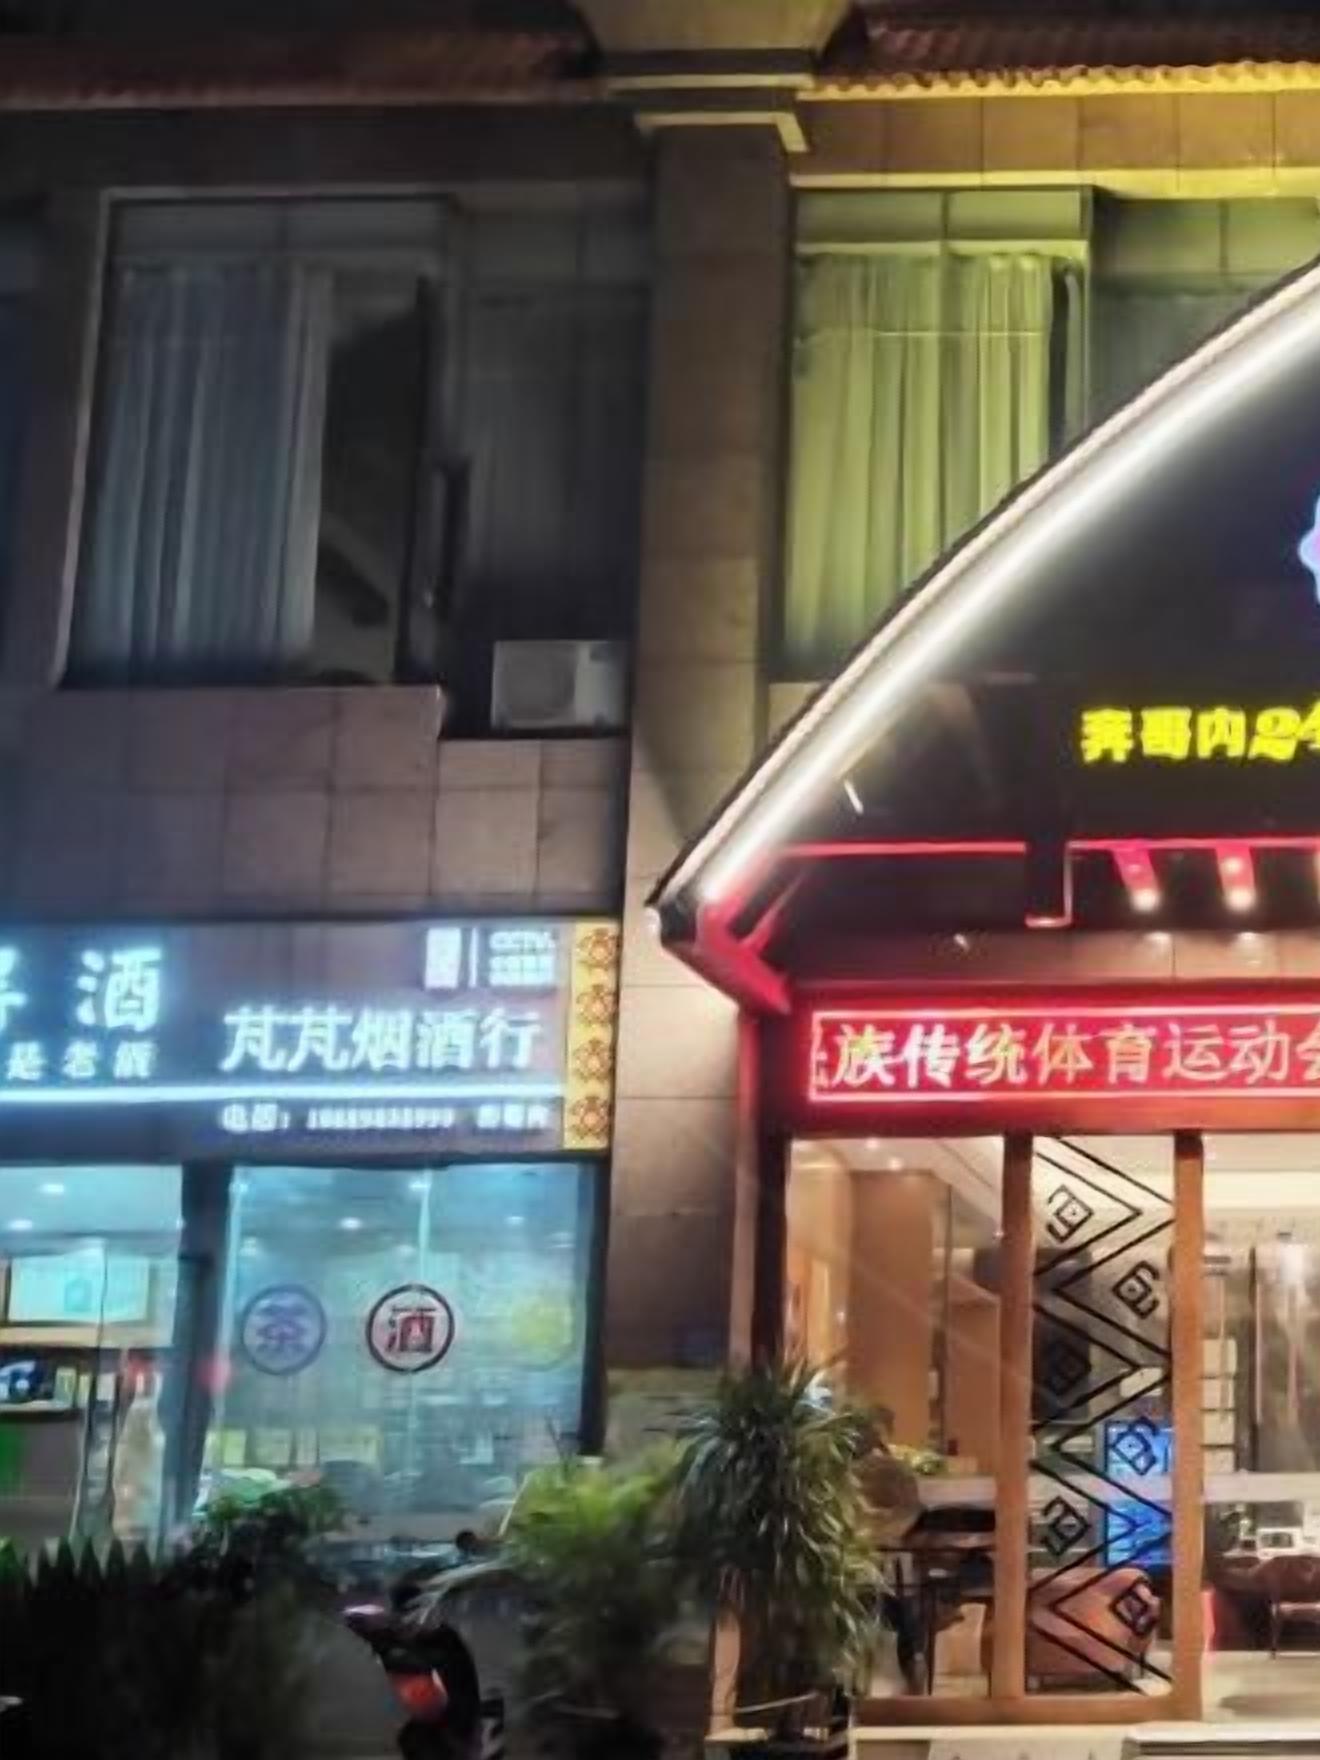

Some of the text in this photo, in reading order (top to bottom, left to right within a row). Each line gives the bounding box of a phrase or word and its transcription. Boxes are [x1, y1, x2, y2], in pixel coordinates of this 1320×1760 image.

[219, 1006, 541, 1071] 芃芃烟酒行
